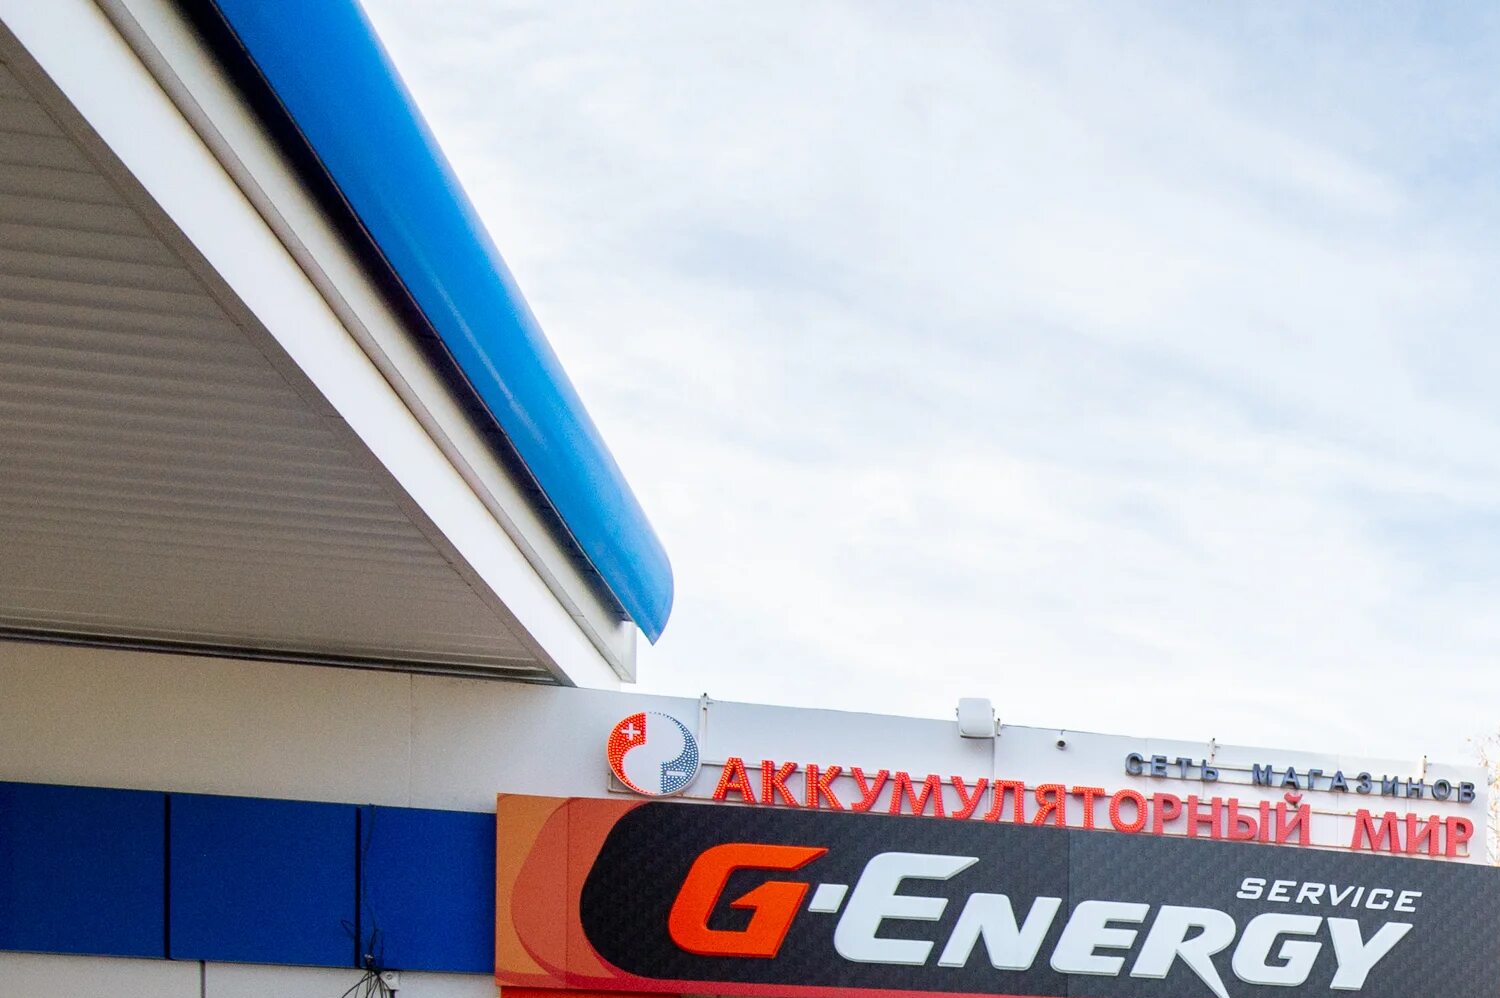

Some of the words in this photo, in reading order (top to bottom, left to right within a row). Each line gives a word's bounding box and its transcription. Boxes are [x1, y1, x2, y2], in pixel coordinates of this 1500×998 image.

[1125, 752, 1219, 782] СЕТЬ
[1252, 763, 1476, 803] МАГАЗИНОВ
[713, 757, 1310, 847] АККУМУЛЯТОРНЫЙ
[1351, 808, 1475, 857] МИР
[1236, 877, 1422, 913] SERVICE
